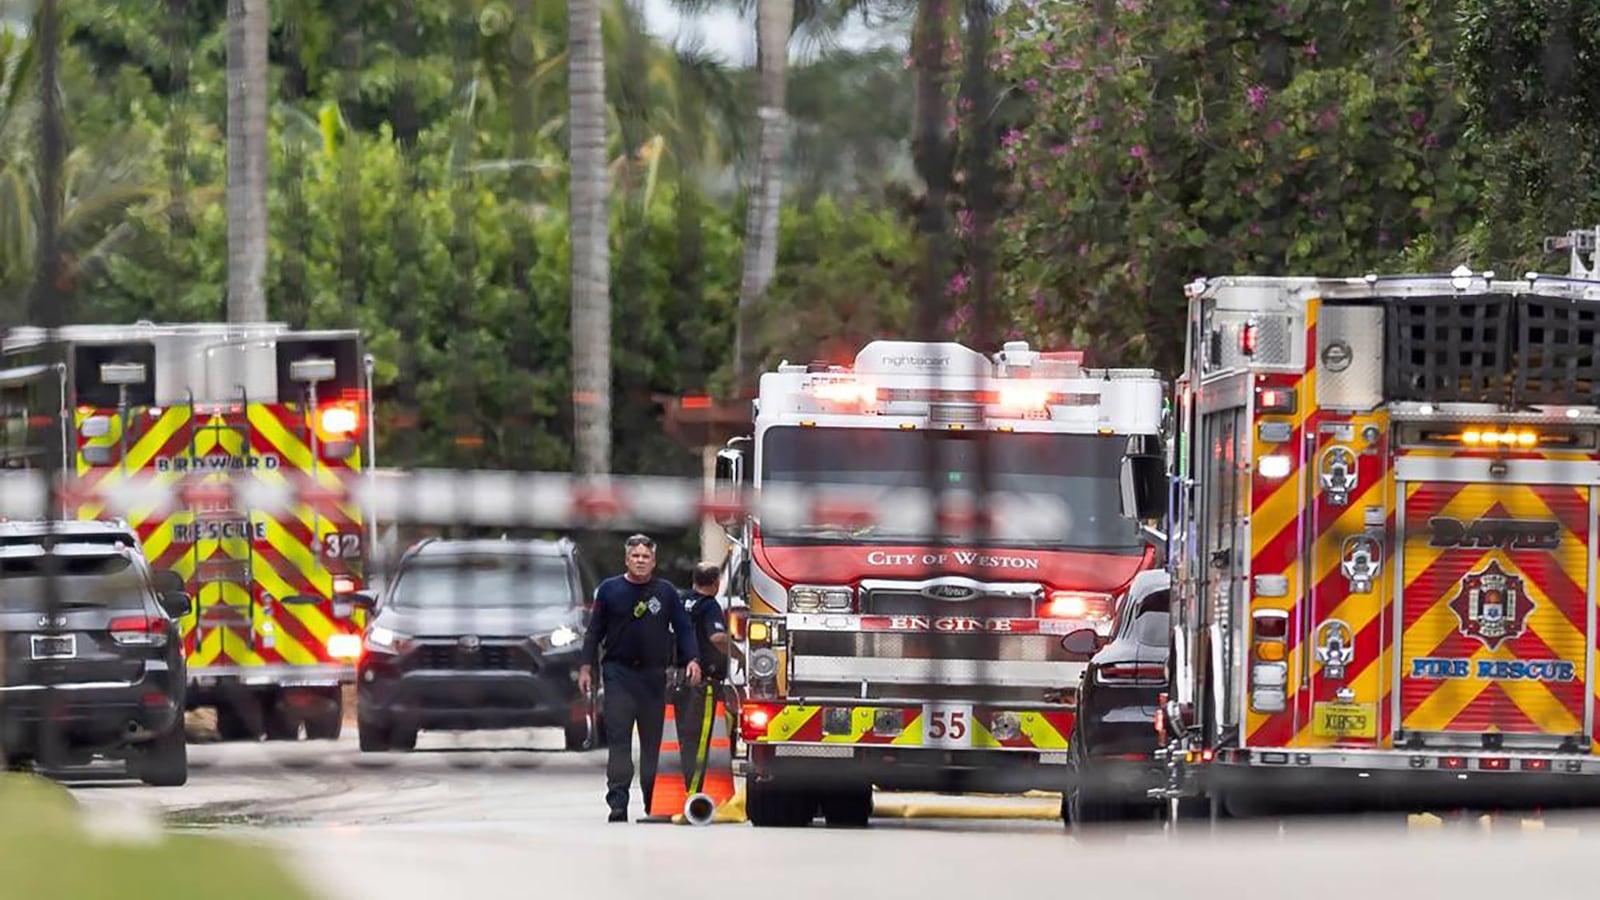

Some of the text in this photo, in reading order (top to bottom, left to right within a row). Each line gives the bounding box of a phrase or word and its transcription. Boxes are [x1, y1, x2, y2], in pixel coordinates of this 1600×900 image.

[156, 454, 280, 474] BROWARD
[173, 520, 268, 542] RESCUE
[325, 533, 361, 559] 32
[890, 617, 1012, 632] ENGINE
[1411, 658, 1575, 682] FIRE RESCUE
[928, 711, 966, 740] 55
